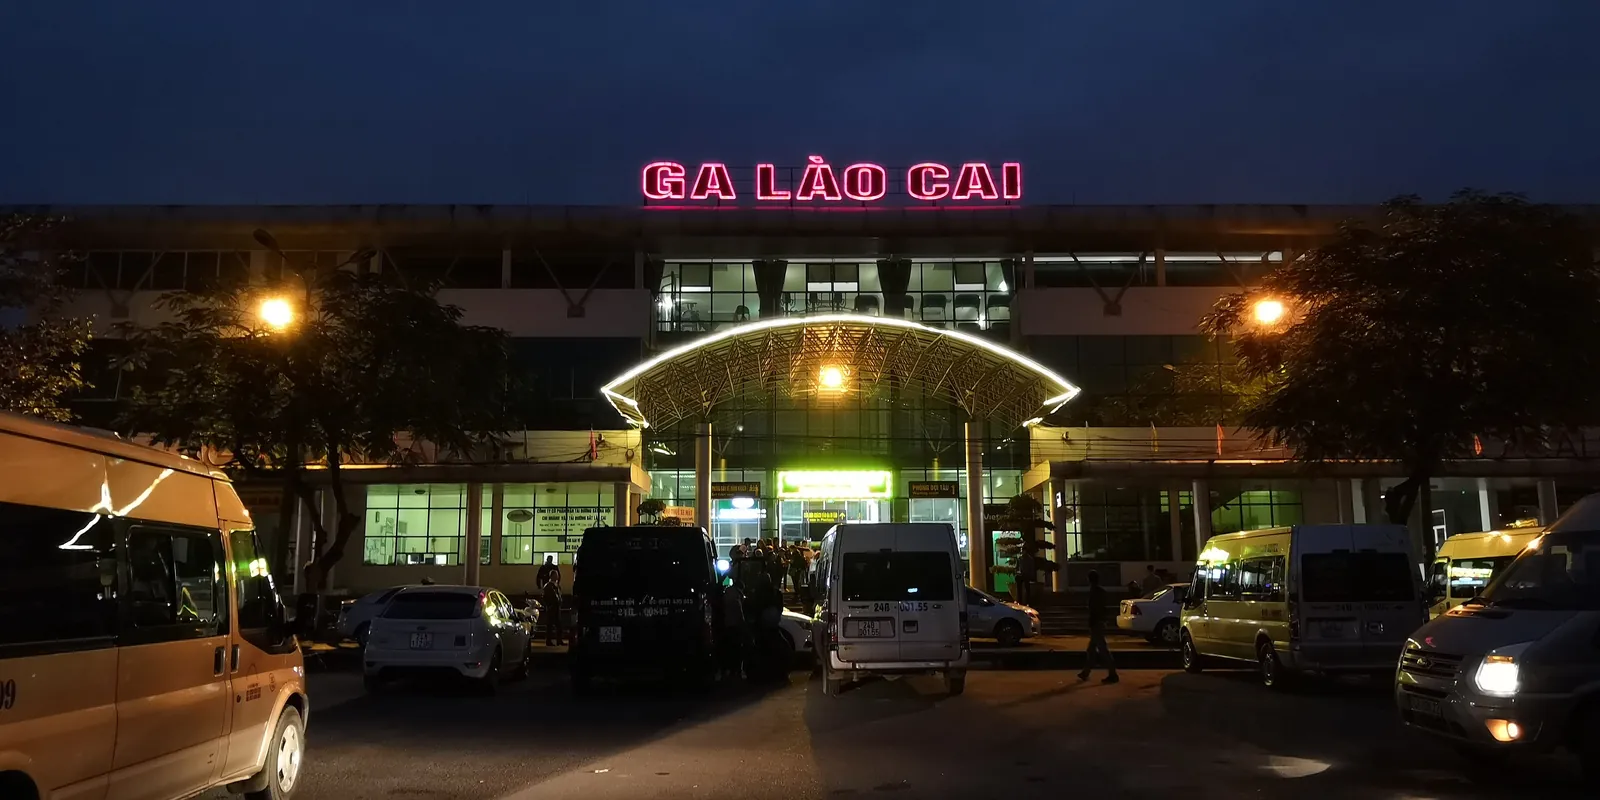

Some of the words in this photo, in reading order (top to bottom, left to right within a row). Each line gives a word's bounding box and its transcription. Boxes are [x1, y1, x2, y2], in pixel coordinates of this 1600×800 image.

[643, 161, 736, 200] GA
[756, 155, 886, 200] LÀO
[907, 162, 1022, 200] CAI
